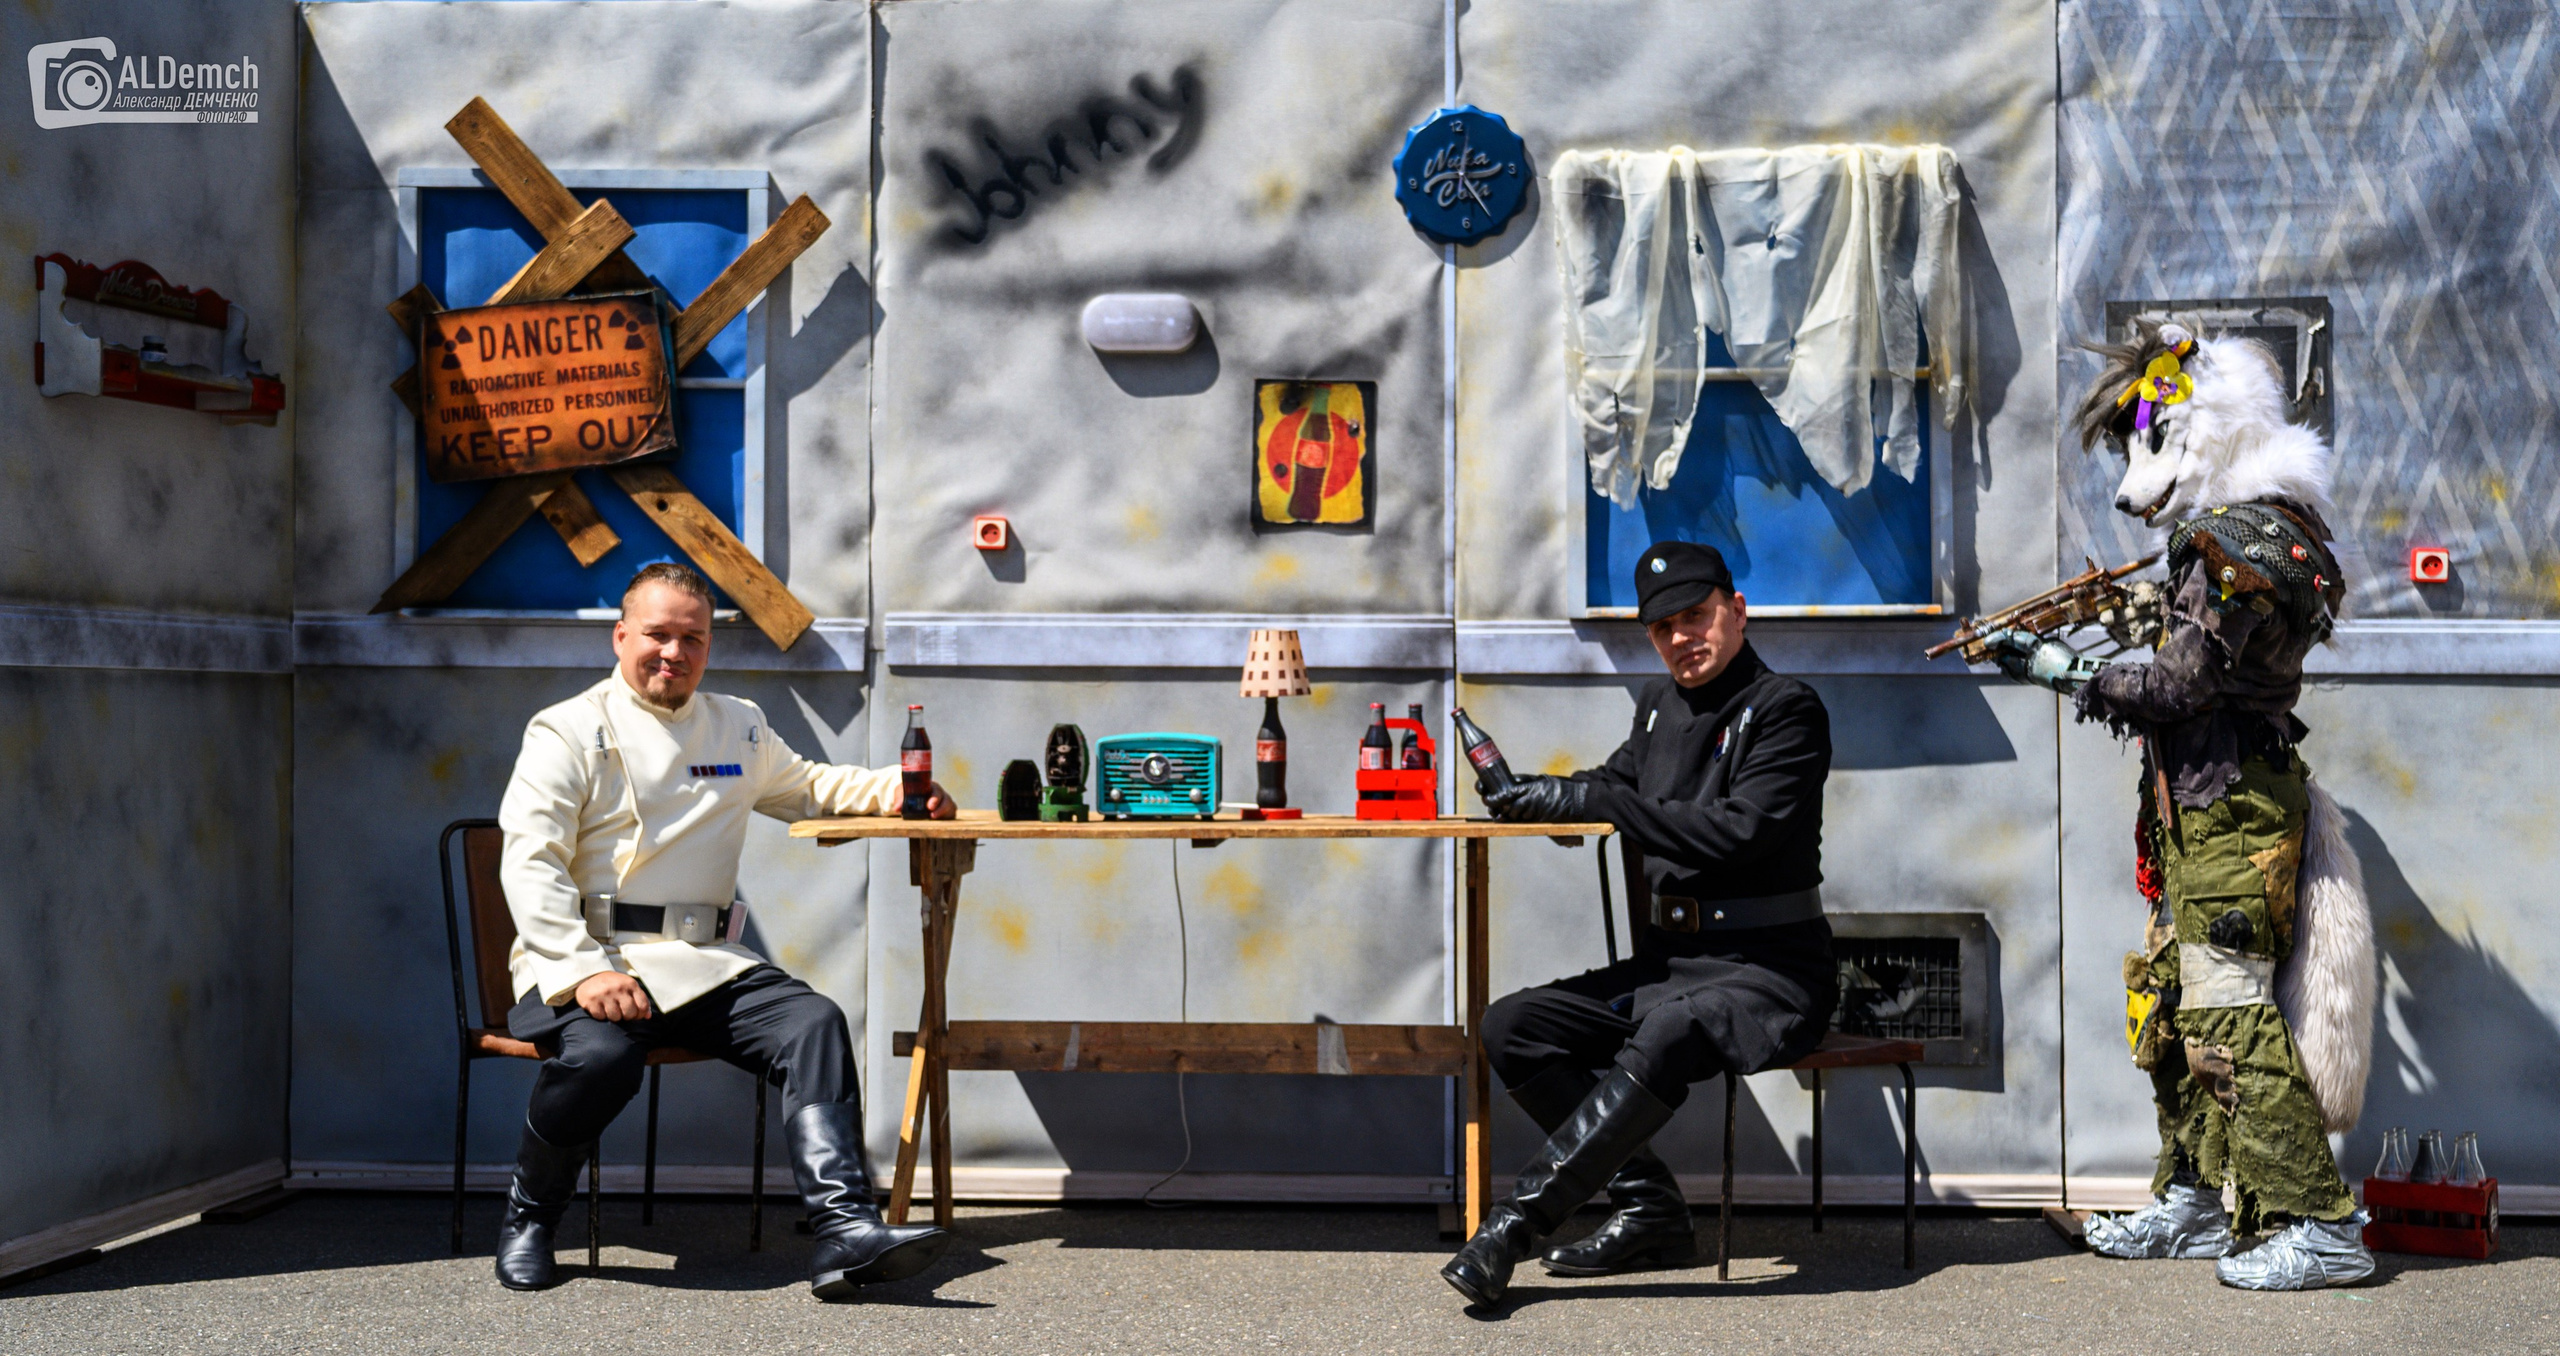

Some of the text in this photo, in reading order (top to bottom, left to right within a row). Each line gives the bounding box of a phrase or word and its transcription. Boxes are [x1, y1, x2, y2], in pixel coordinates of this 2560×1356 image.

[1450, 120, 1464, 133] 12
[1507, 163, 1517, 175] 3
[1408, 178, 1418, 190] 9
[1461, 216, 1471, 230] 6
[478, 313, 604, 363] DANGER
[450, 361, 642, 396] RADIOACTIVE MATERIALS
[440, 387, 657, 424] UNAUTHORIZED PERSONNEL
[440, 425, 553, 465] KEEP
